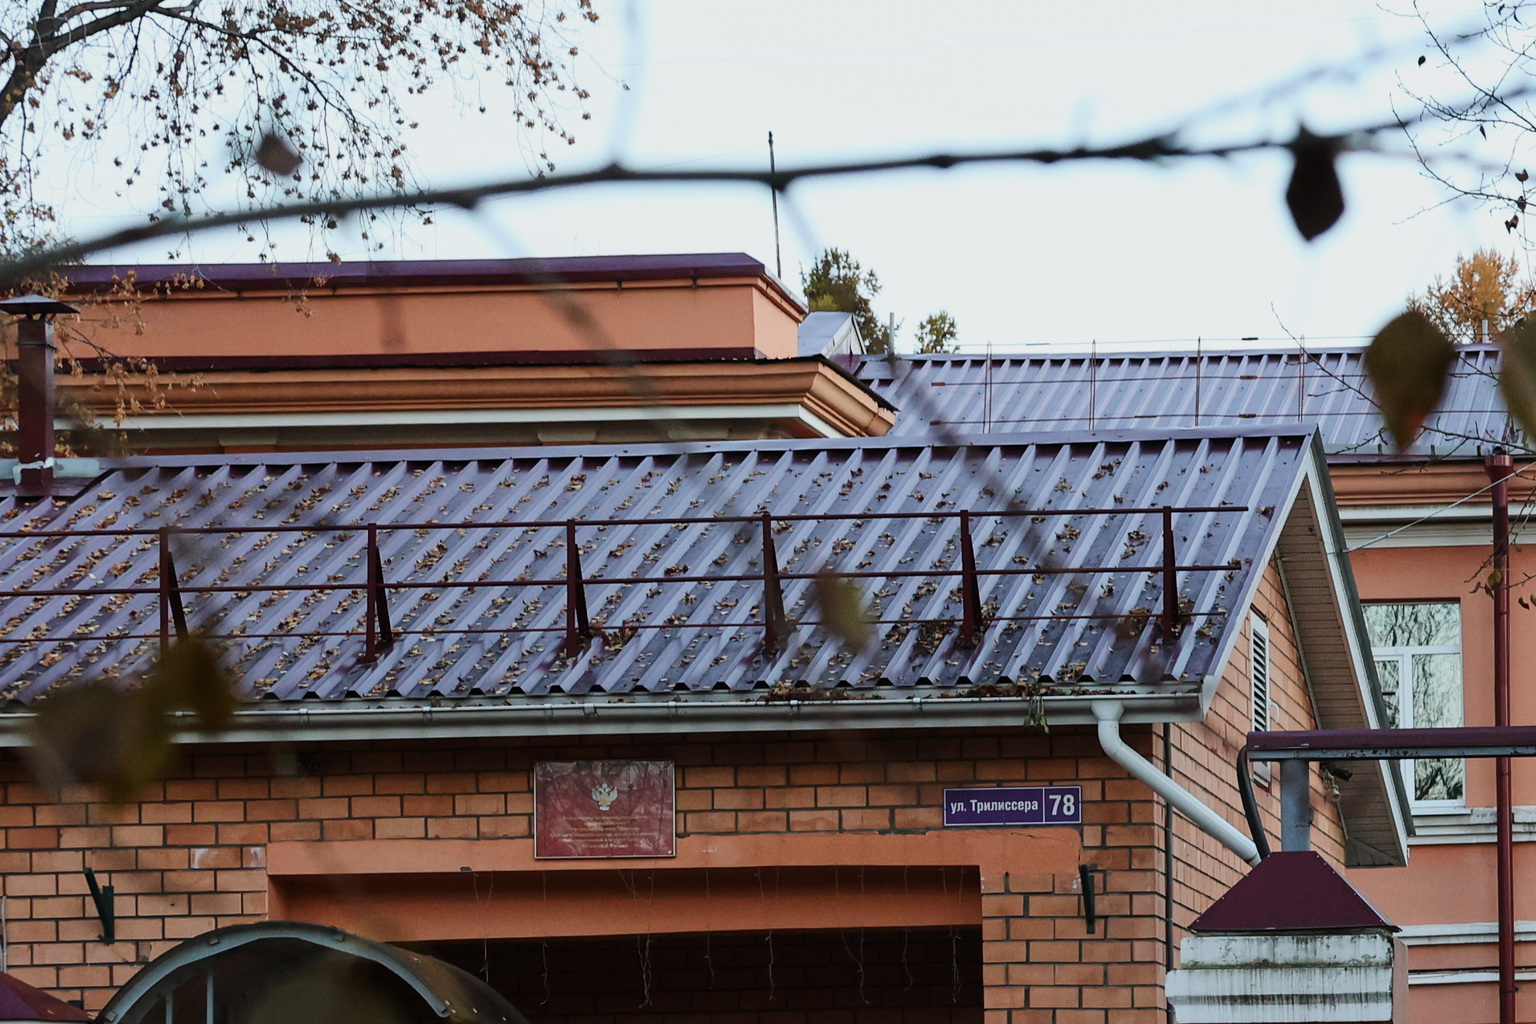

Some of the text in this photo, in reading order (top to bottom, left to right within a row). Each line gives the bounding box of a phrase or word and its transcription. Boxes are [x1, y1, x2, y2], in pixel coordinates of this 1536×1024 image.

[950, 794, 1075, 816] ул. Трилиссера 78
